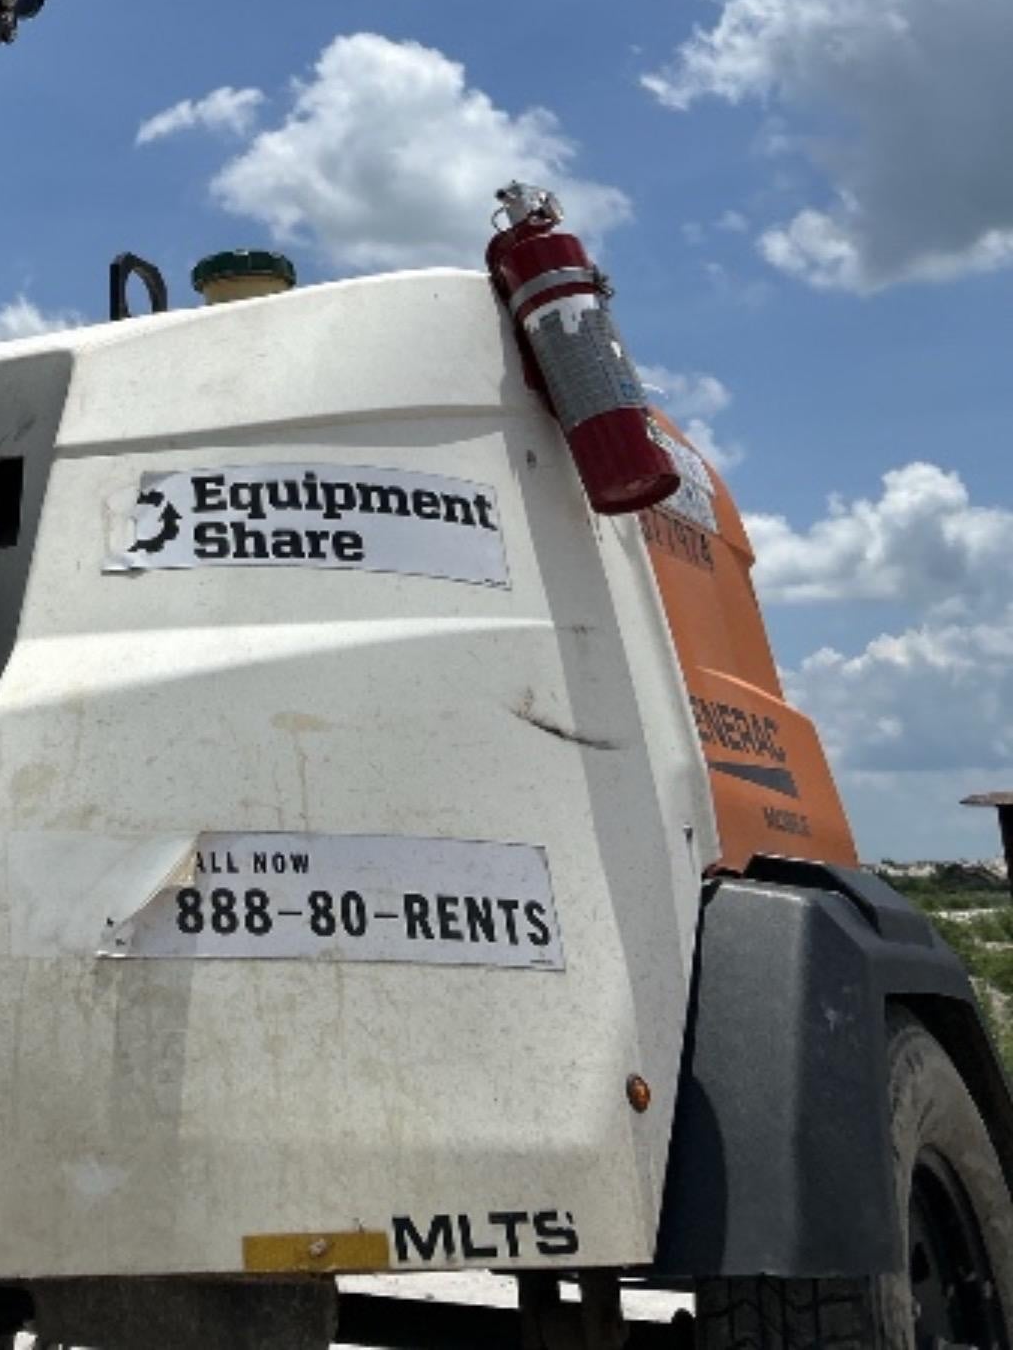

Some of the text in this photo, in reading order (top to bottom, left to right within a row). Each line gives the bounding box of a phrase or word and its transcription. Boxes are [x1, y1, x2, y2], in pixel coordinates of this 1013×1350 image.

[190, 470, 499, 532] Equipment
[192, 521, 367, 562] Share
[689, 694, 787, 763] ENERAC
[195, 851, 310, 874] ALL NOW
[175, 886, 552, 947] 888-80-RENTS
[391, 1210, 580, 1263] MLTS
